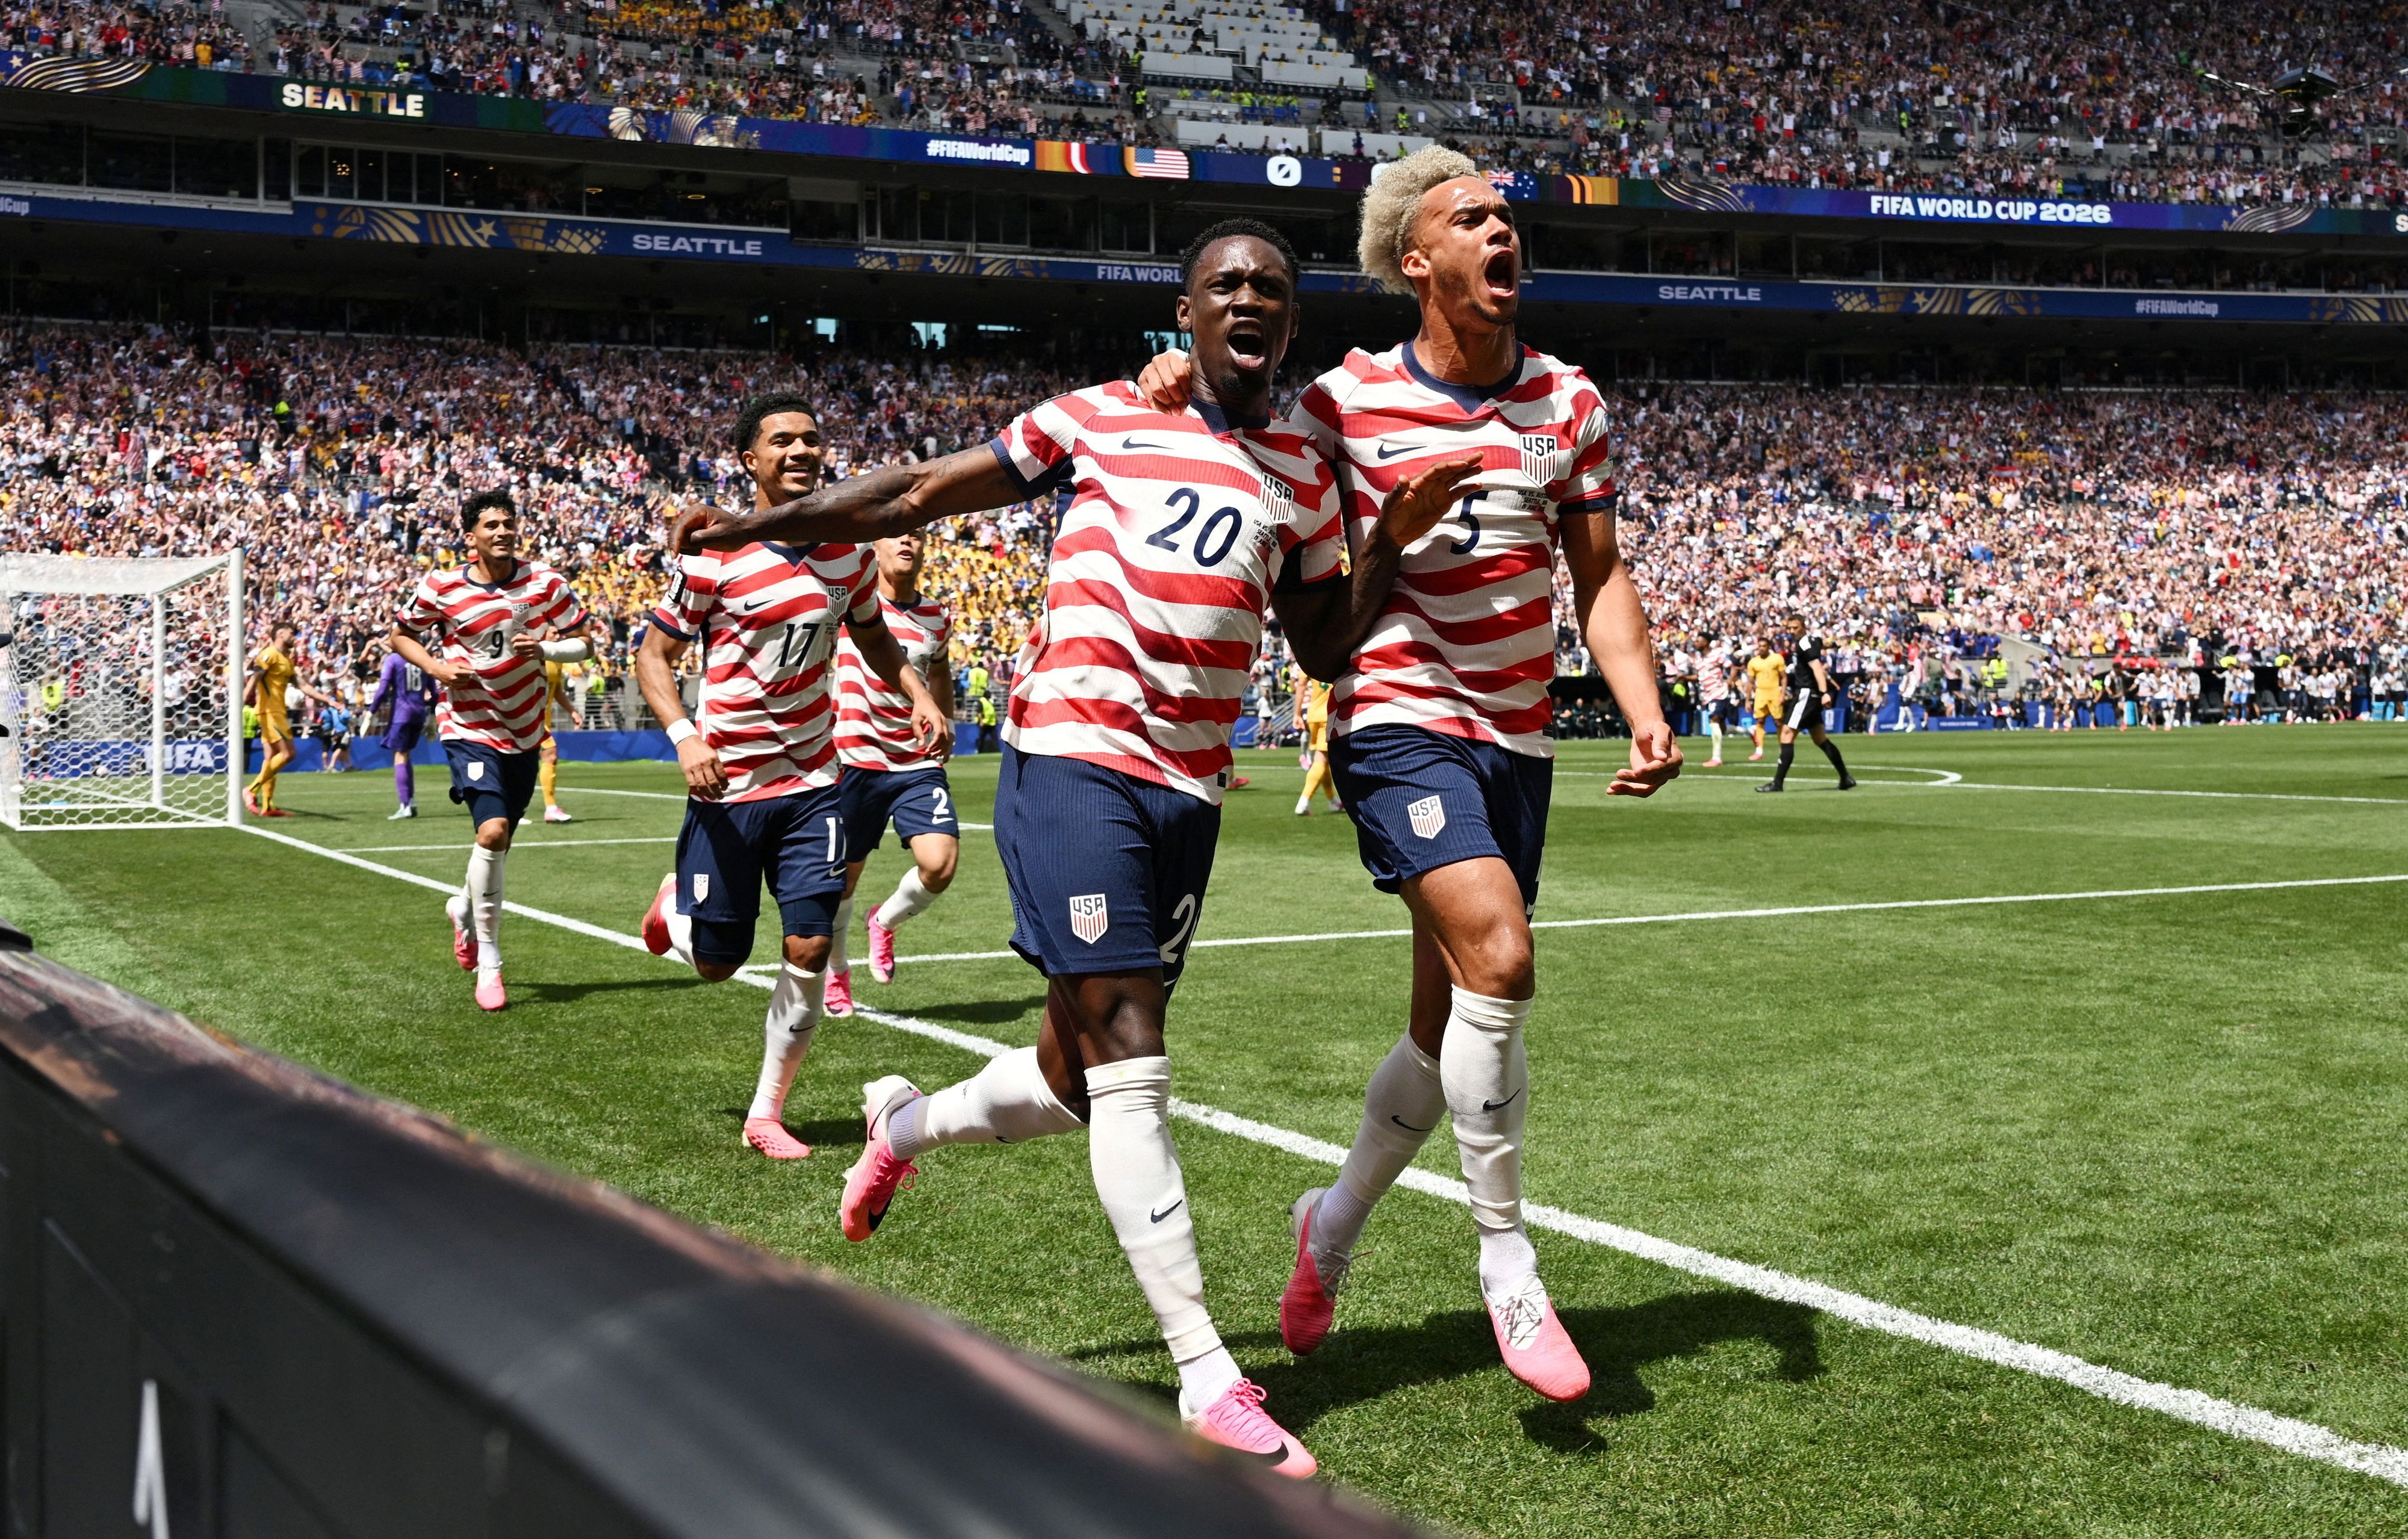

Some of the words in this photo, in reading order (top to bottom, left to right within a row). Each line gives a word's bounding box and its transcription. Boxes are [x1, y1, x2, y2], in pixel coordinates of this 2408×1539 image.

[964, 43, 1002, 57] 334
[282, 83, 424, 117] SEATTLE
[926, 139, 1030, 166] #FIFAWorldCup
[1870, 194, 1916, 216] FIFA
[1917, 197, 1993, 219] WORLD
[1996, 200, 2037, 220] CUP
[2039, 202, 2112, 224] 2026
[633, 234, 762, 255] SEATTLE
[1097, 265, 1132, 281] FIFA
[1134, 267, 1183, 283] WORL
[1659, 286, 1761, 301] SEATTLE
[2135, 300, 2218, 317] #FIFAWorldCup
[1522, 437, 1555, 457] USA
[1264, 474, 1292, 501] USA
[1145, 488, 1242, 567] 20
[1450, 490, 1489, 555] 5
[828, 587, 846, 600] USA
[513, 604, 528, 613] USA
[491, 630, 504, 659] 9
[778, 623, 821, 667] 17
[405, 662, 422, 691] 18
[932, 787, 949, 816] 2
[1410, 797, 1439, 817] USA
[826, 817, 846, 861] 1
[1073, 896, 1103, 916] USA
[1159, 893, 1201, 964] 2
